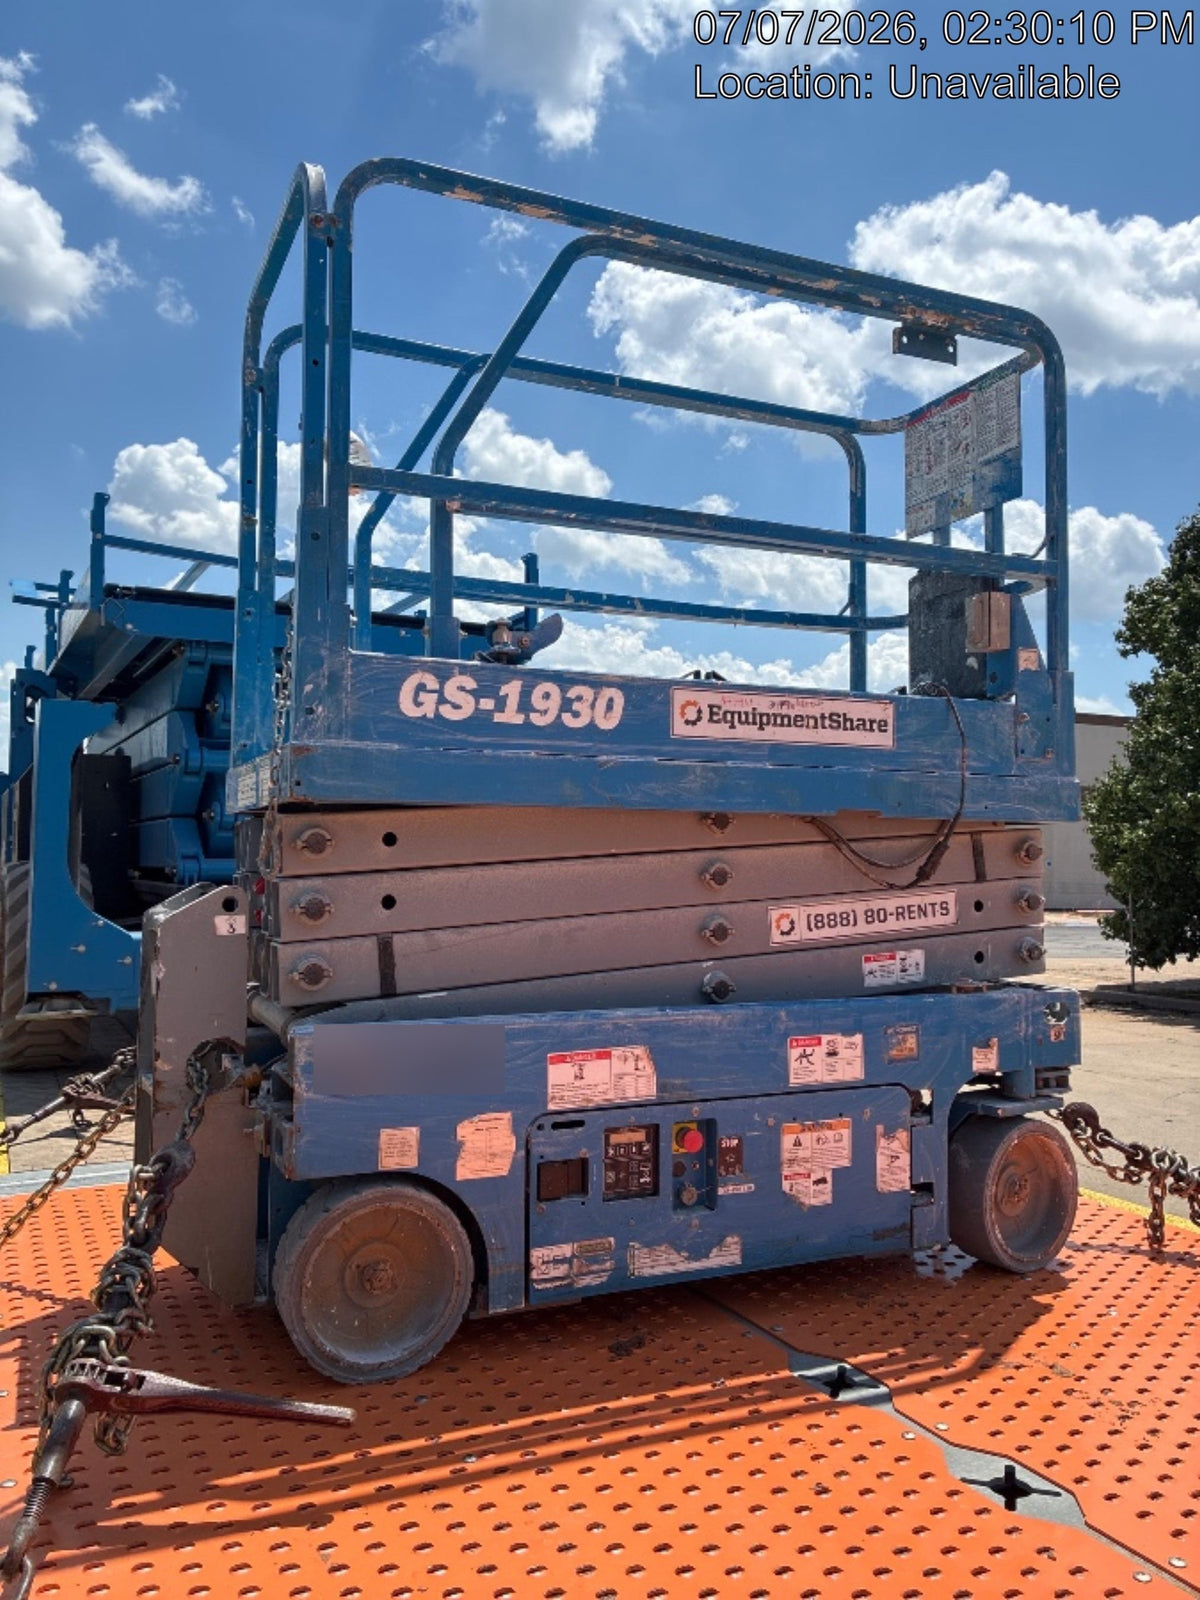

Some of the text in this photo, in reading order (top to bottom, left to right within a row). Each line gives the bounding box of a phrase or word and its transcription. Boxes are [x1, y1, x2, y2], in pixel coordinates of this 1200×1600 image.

[399, 671, 625, 730] GS-1930
[707, 704, 889, 733] EquipmentShare
[806, 901, 950, 932] (888) 80-RENTS
